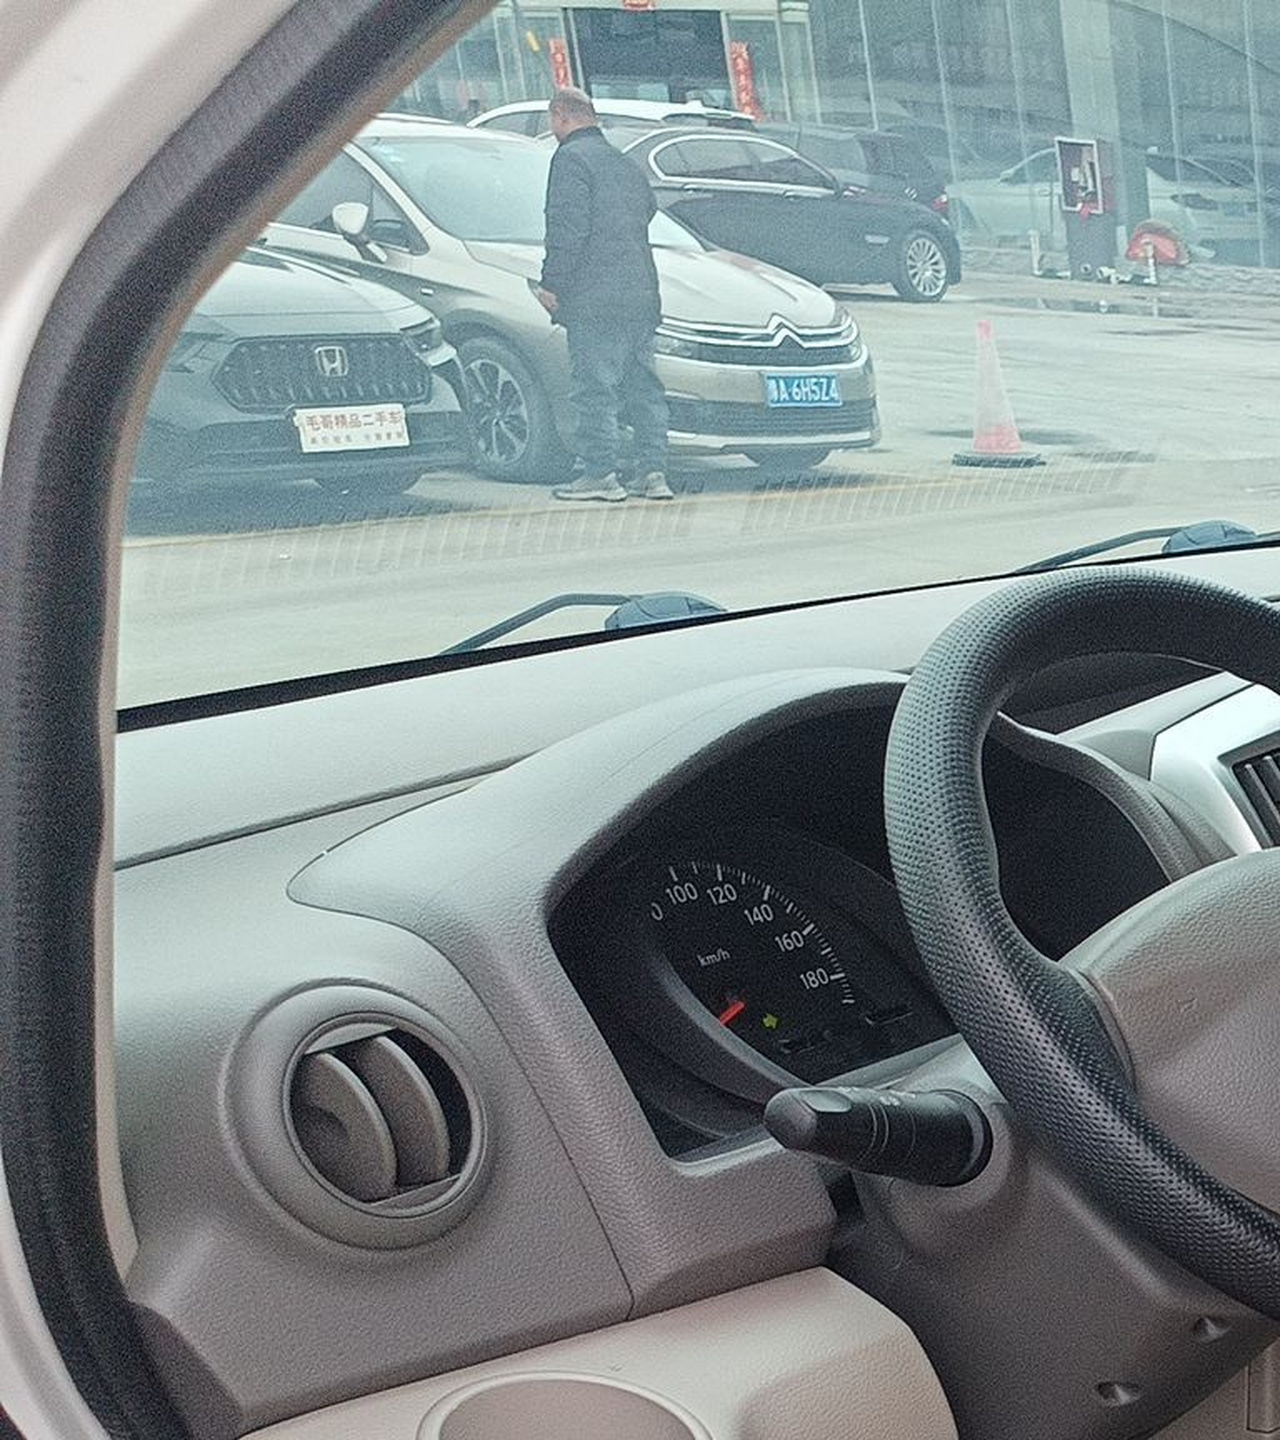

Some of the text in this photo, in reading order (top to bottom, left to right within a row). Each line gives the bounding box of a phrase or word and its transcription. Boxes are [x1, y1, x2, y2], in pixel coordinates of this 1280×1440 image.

[665, 882, 698, 905] 100
[706, 883, 738, 906] 120
[744, 903, 774, 926] 140
[774, 930, 805, 952] 160
[698, 948, 731, 967] km/h
[800, 967, 830, 990] 180
